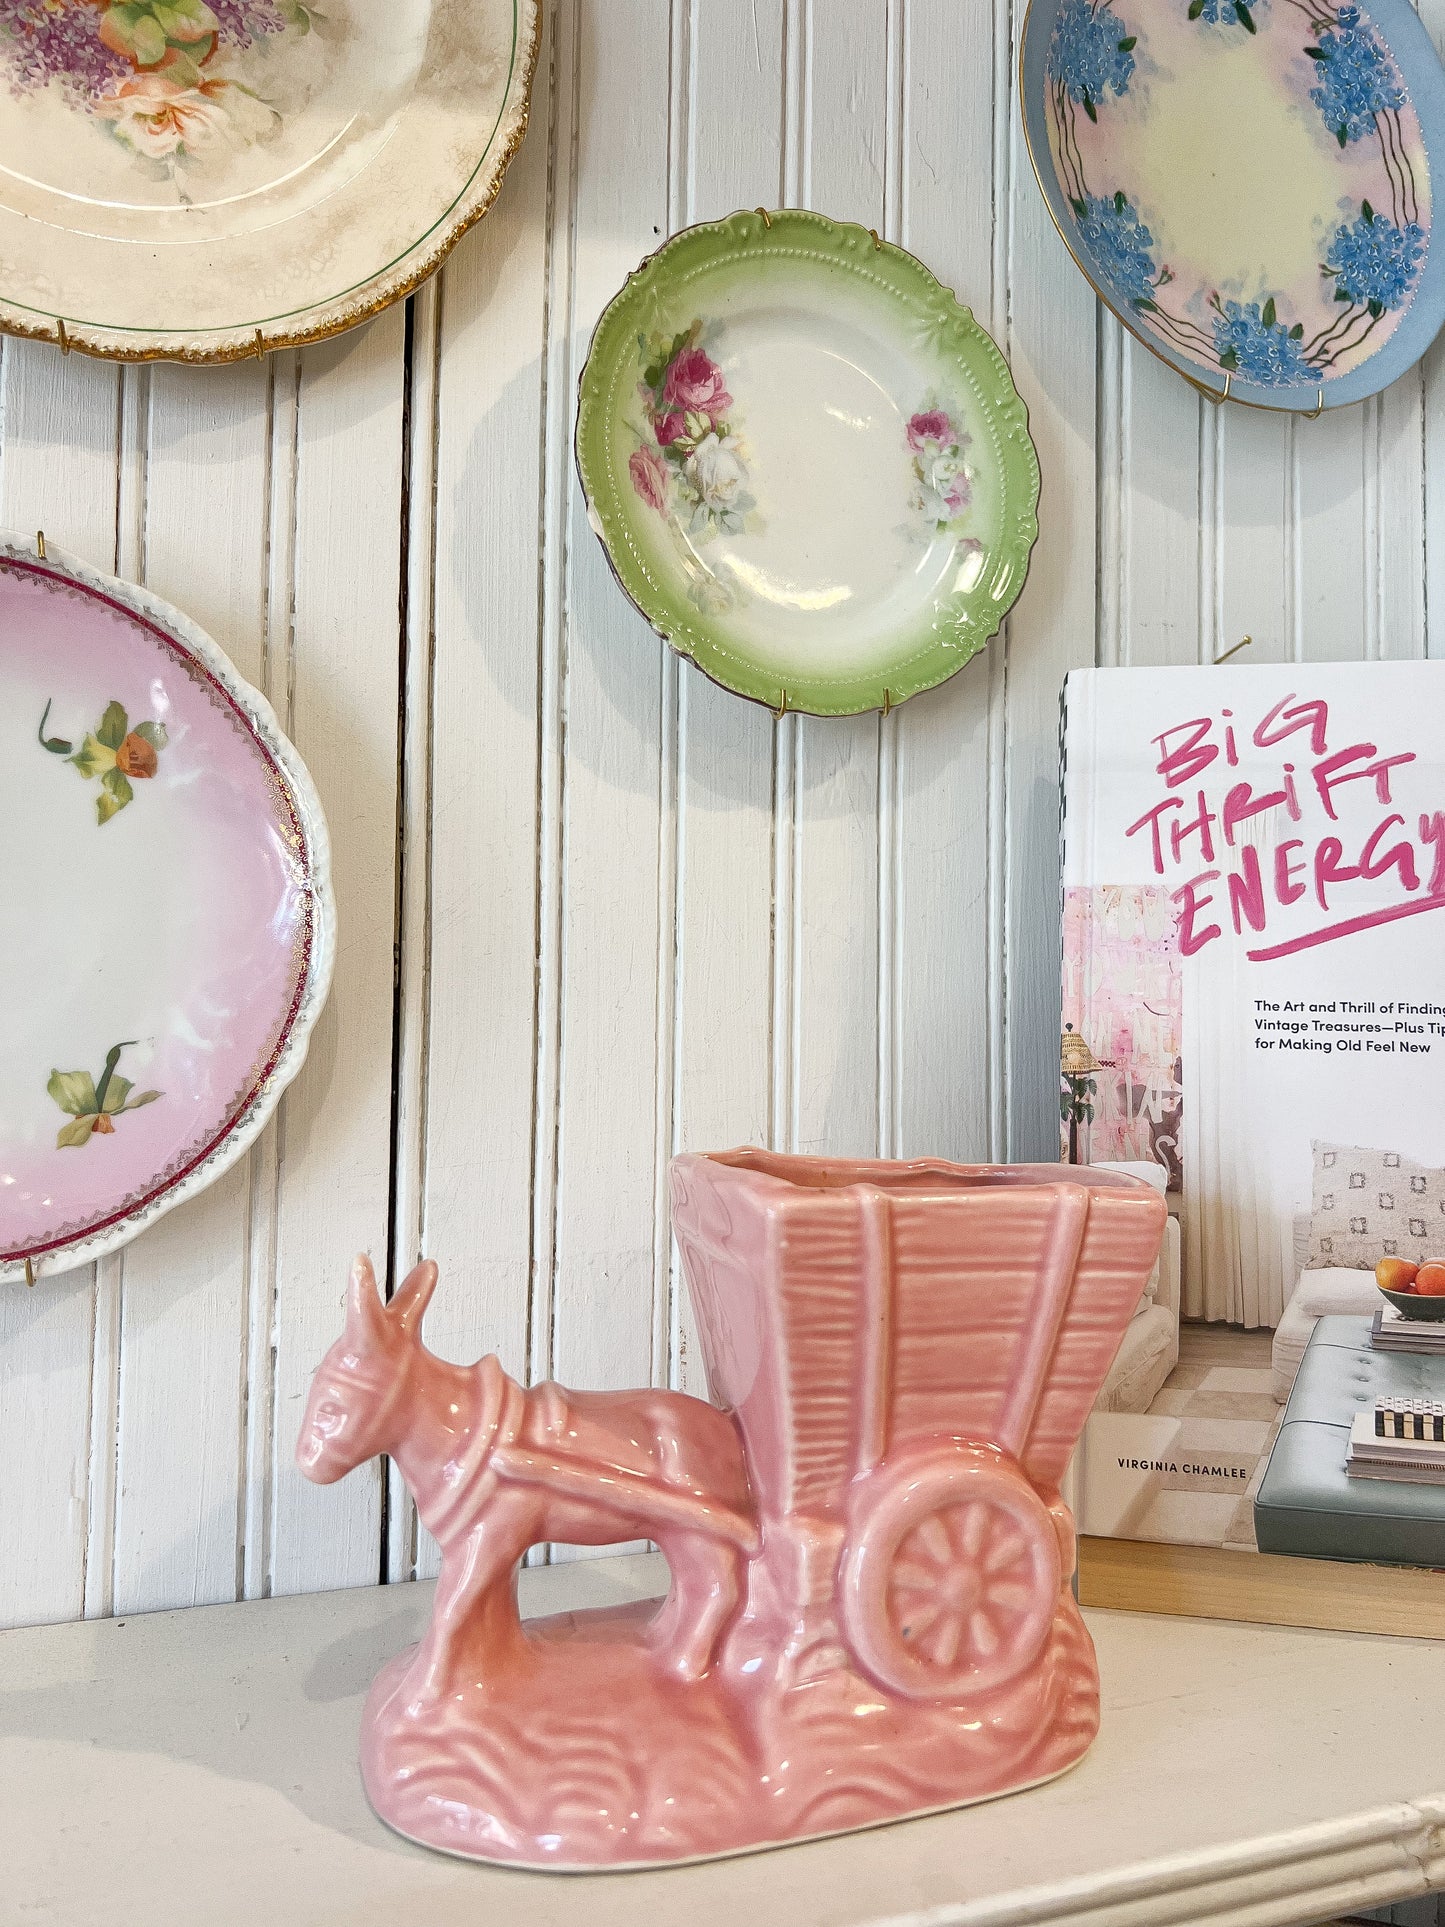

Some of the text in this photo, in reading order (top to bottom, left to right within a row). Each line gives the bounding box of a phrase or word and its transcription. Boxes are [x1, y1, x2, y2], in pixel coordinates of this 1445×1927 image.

[1254, 1000, 1280, 1012] The
[1283, 1000, 1305, 1012] Art
[1308, 1001, 1336, 1013] and
[1339, 1001, 1375, 1014] Thrill
[1379, 1002, 1394, 1014] of
[1254, 1018, 1309, 1034] Vintage
[1254, 1037, 1431, 1054] for Making Old Feel New
[1117, 1457, 1247, 1479] VIRGINIA CHAMLEE
